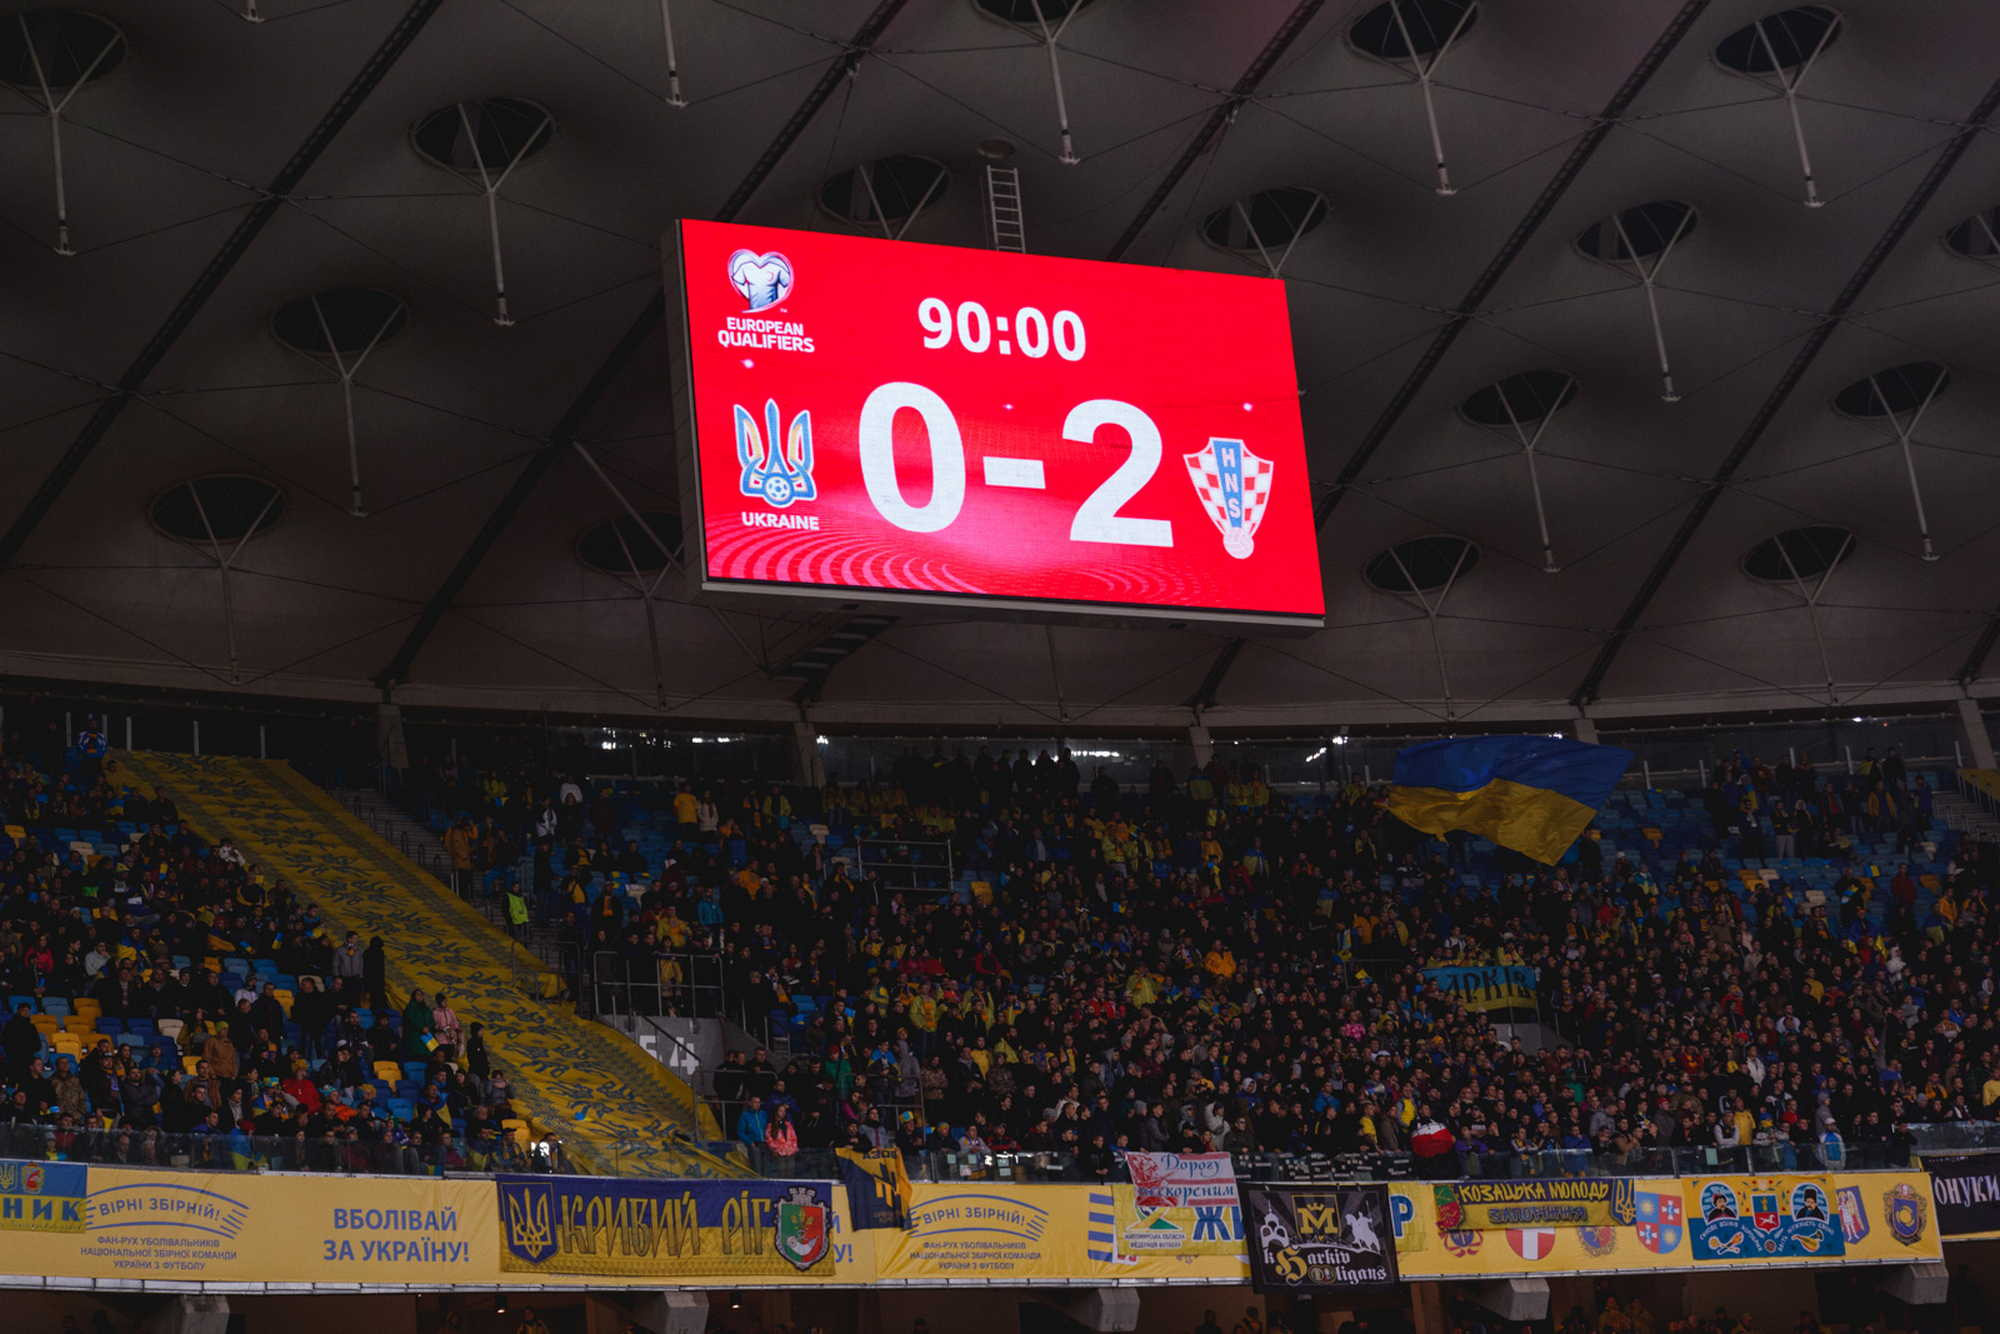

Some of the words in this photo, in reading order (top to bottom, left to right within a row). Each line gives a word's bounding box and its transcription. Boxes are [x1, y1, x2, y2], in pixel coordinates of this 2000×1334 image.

[726, 316, 804, 336] EUROPEAN
[917, 297, 1087, 362] 90:00
[717, 330, 815, 353] QUALIFIERS
[1221, 448, 1241, 518] HNS
[741, 511, 820, 530] UKRAINE
[99, 1199, 143, 1216] ВІРНІ
[150, 1197, 221, 1221] ЗБІРНІЙ!
[334, 1206, 457, 1232] ВБОЛІВАЙ
[923, 1208, 959, 1224] ВІРНІ
[966, 1207, 1025, 1226] ЗБІРНІЙ!
[560, 1191, 697, 1258] КРИВИЙ
[722, 1190, 771, 1255] РІГ
[323, 1241, 358, 1261] ЗА
[362, 1239, 469, 1263] УКРАЇНУ!
